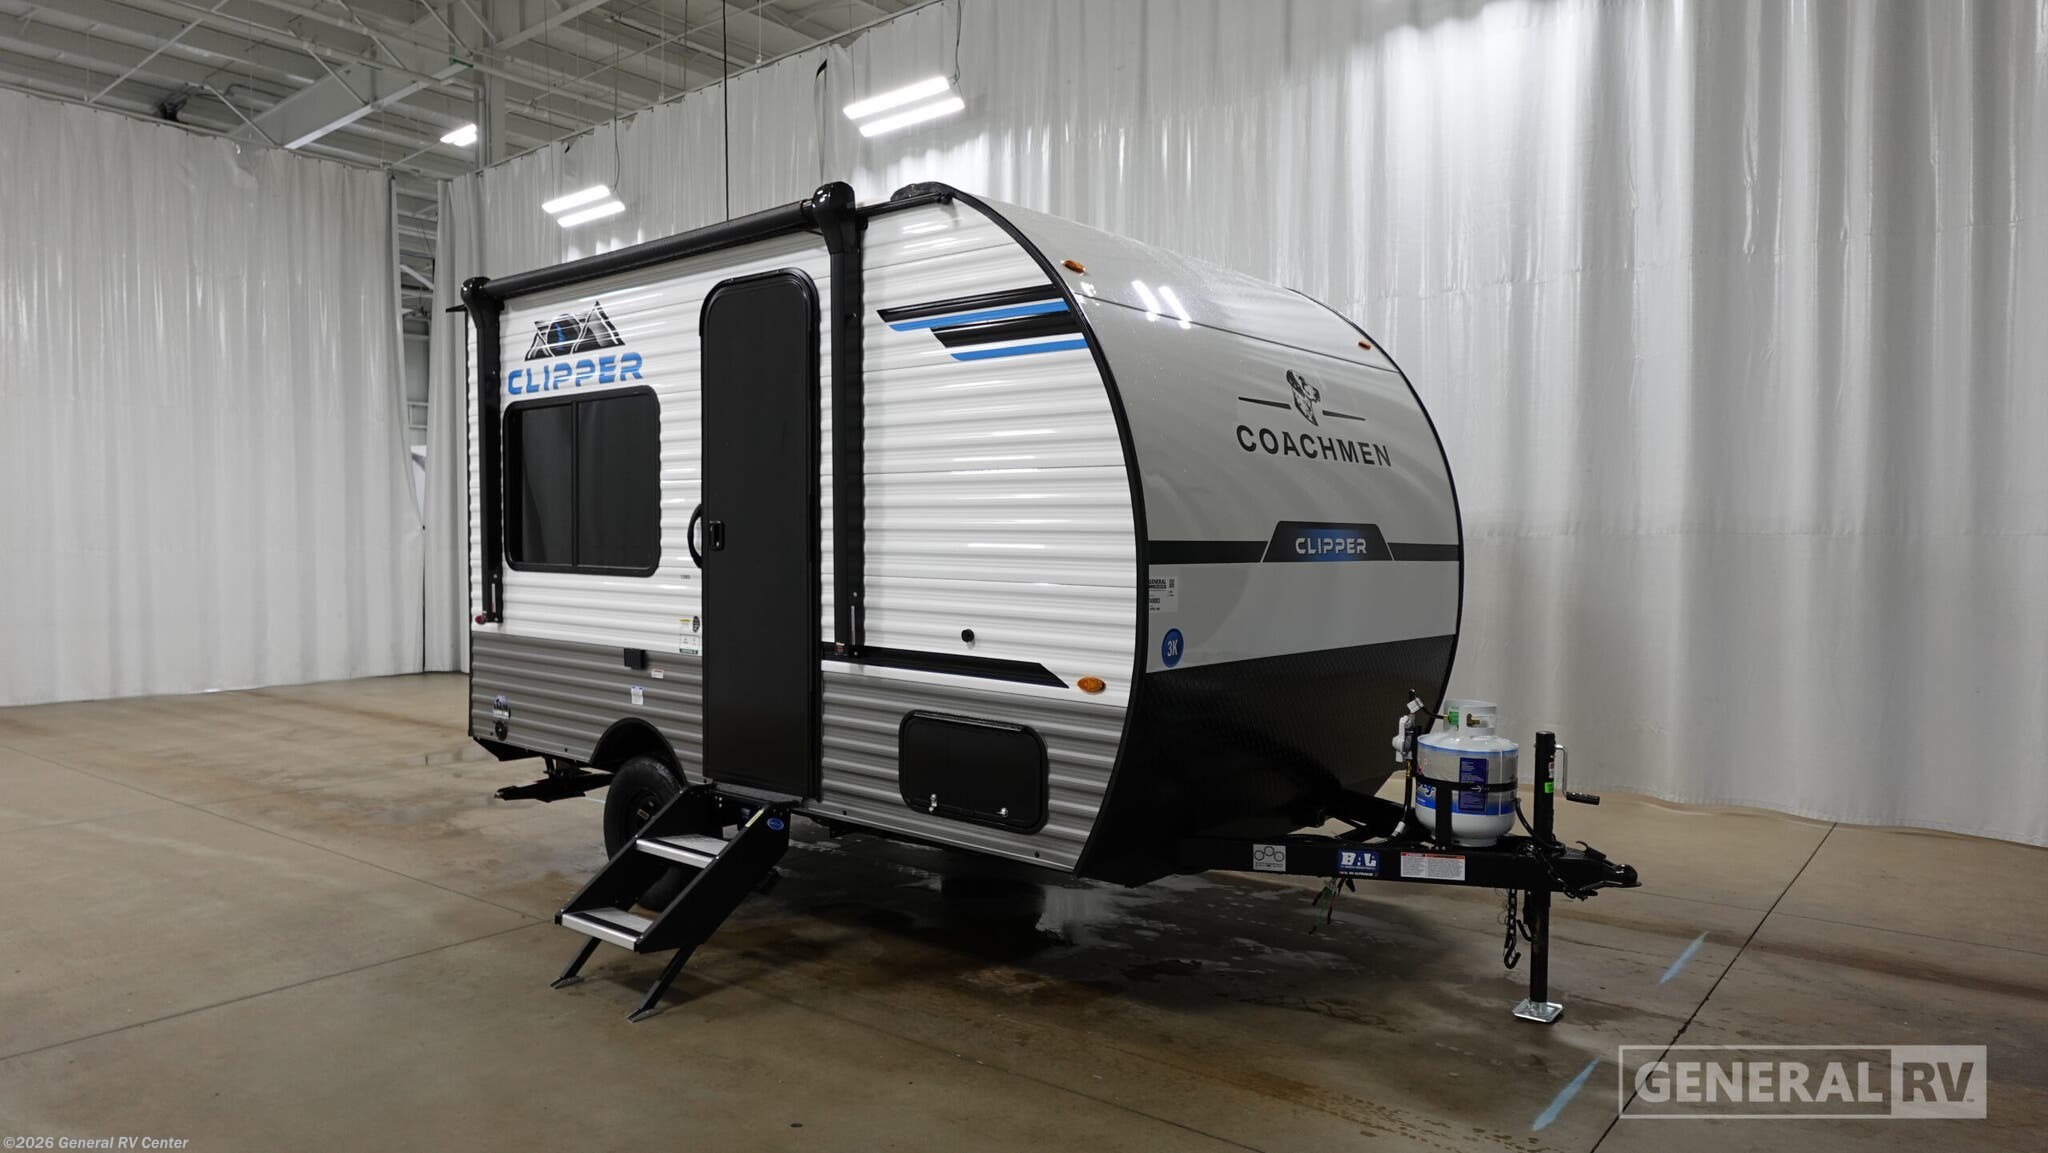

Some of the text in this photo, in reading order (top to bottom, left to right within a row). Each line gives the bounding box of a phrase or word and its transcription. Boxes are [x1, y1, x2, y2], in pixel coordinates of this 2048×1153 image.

[507, 351, 643, 396] CLIPPER
[1236, 424, 1392, 467] COACHMEN
[1295, 537, 1367, 554] CLIPPER
[1167, 639, 1178, 657] 3K
